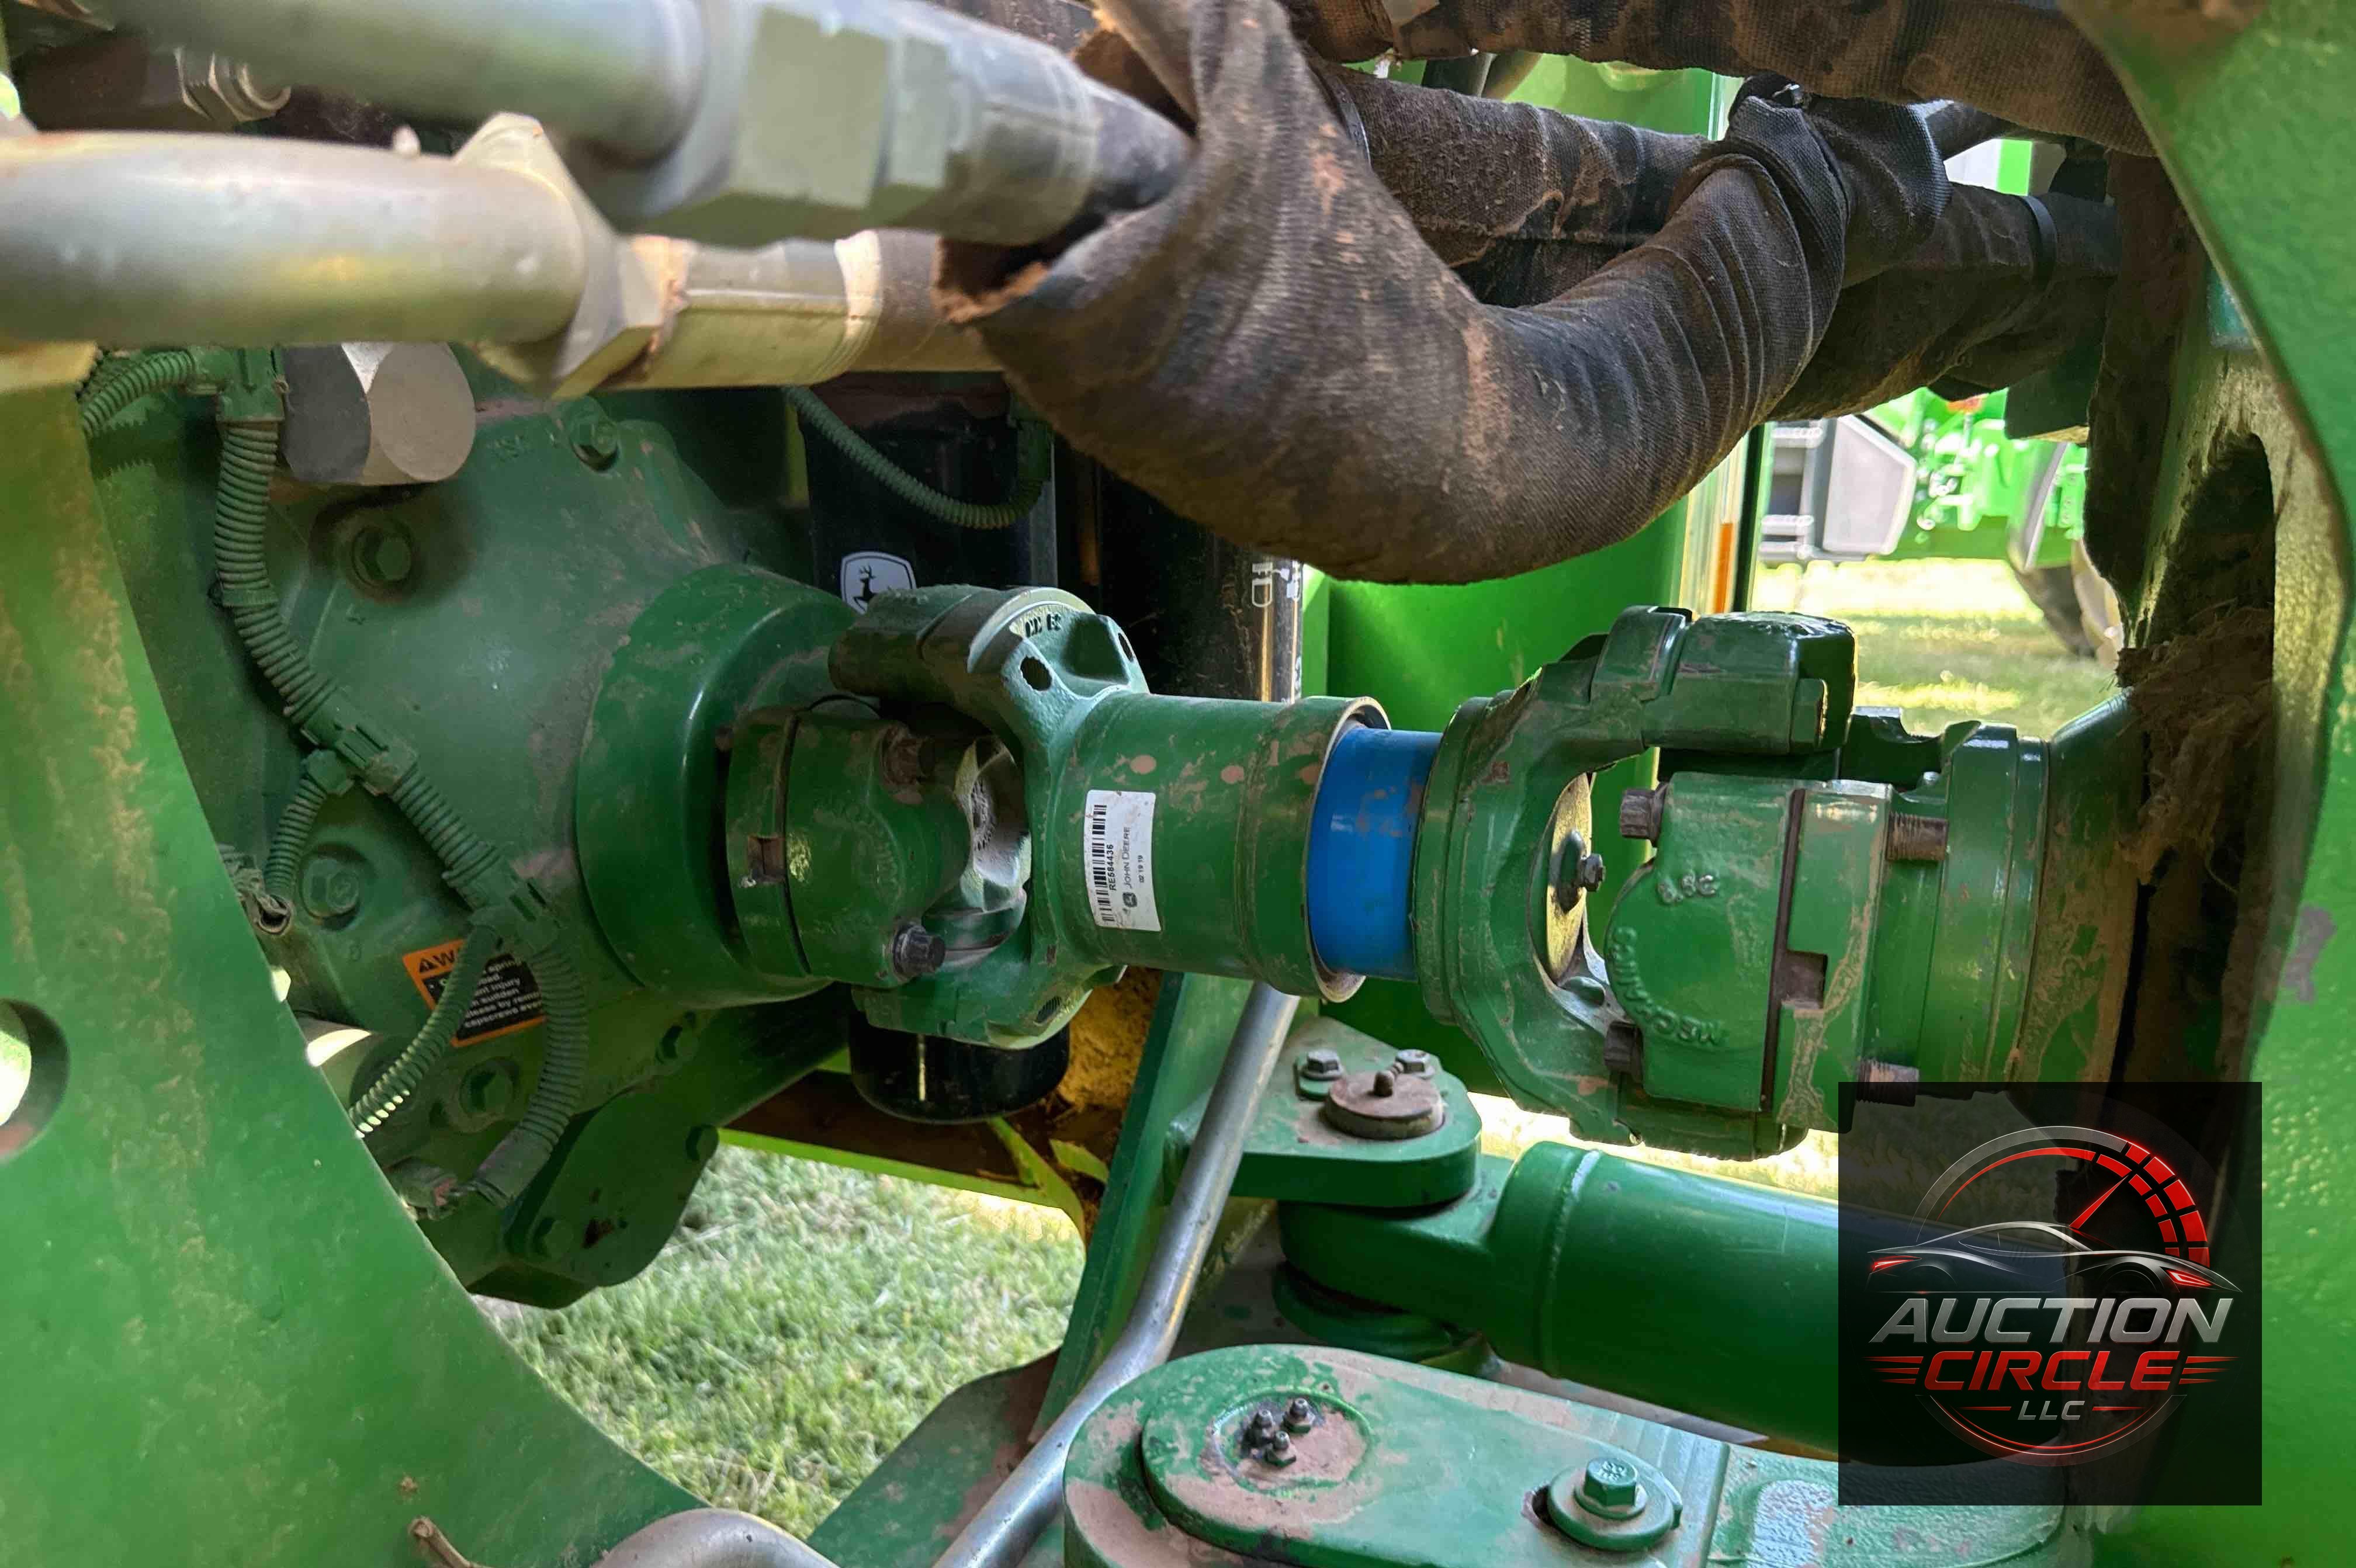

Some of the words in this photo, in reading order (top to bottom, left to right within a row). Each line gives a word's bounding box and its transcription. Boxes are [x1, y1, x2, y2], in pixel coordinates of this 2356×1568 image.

[1122, 827, 1131, 860] DEERE
[1107, 844, 1117, 890] RE584436
[1122, 862, 1132, 889] JOHN
